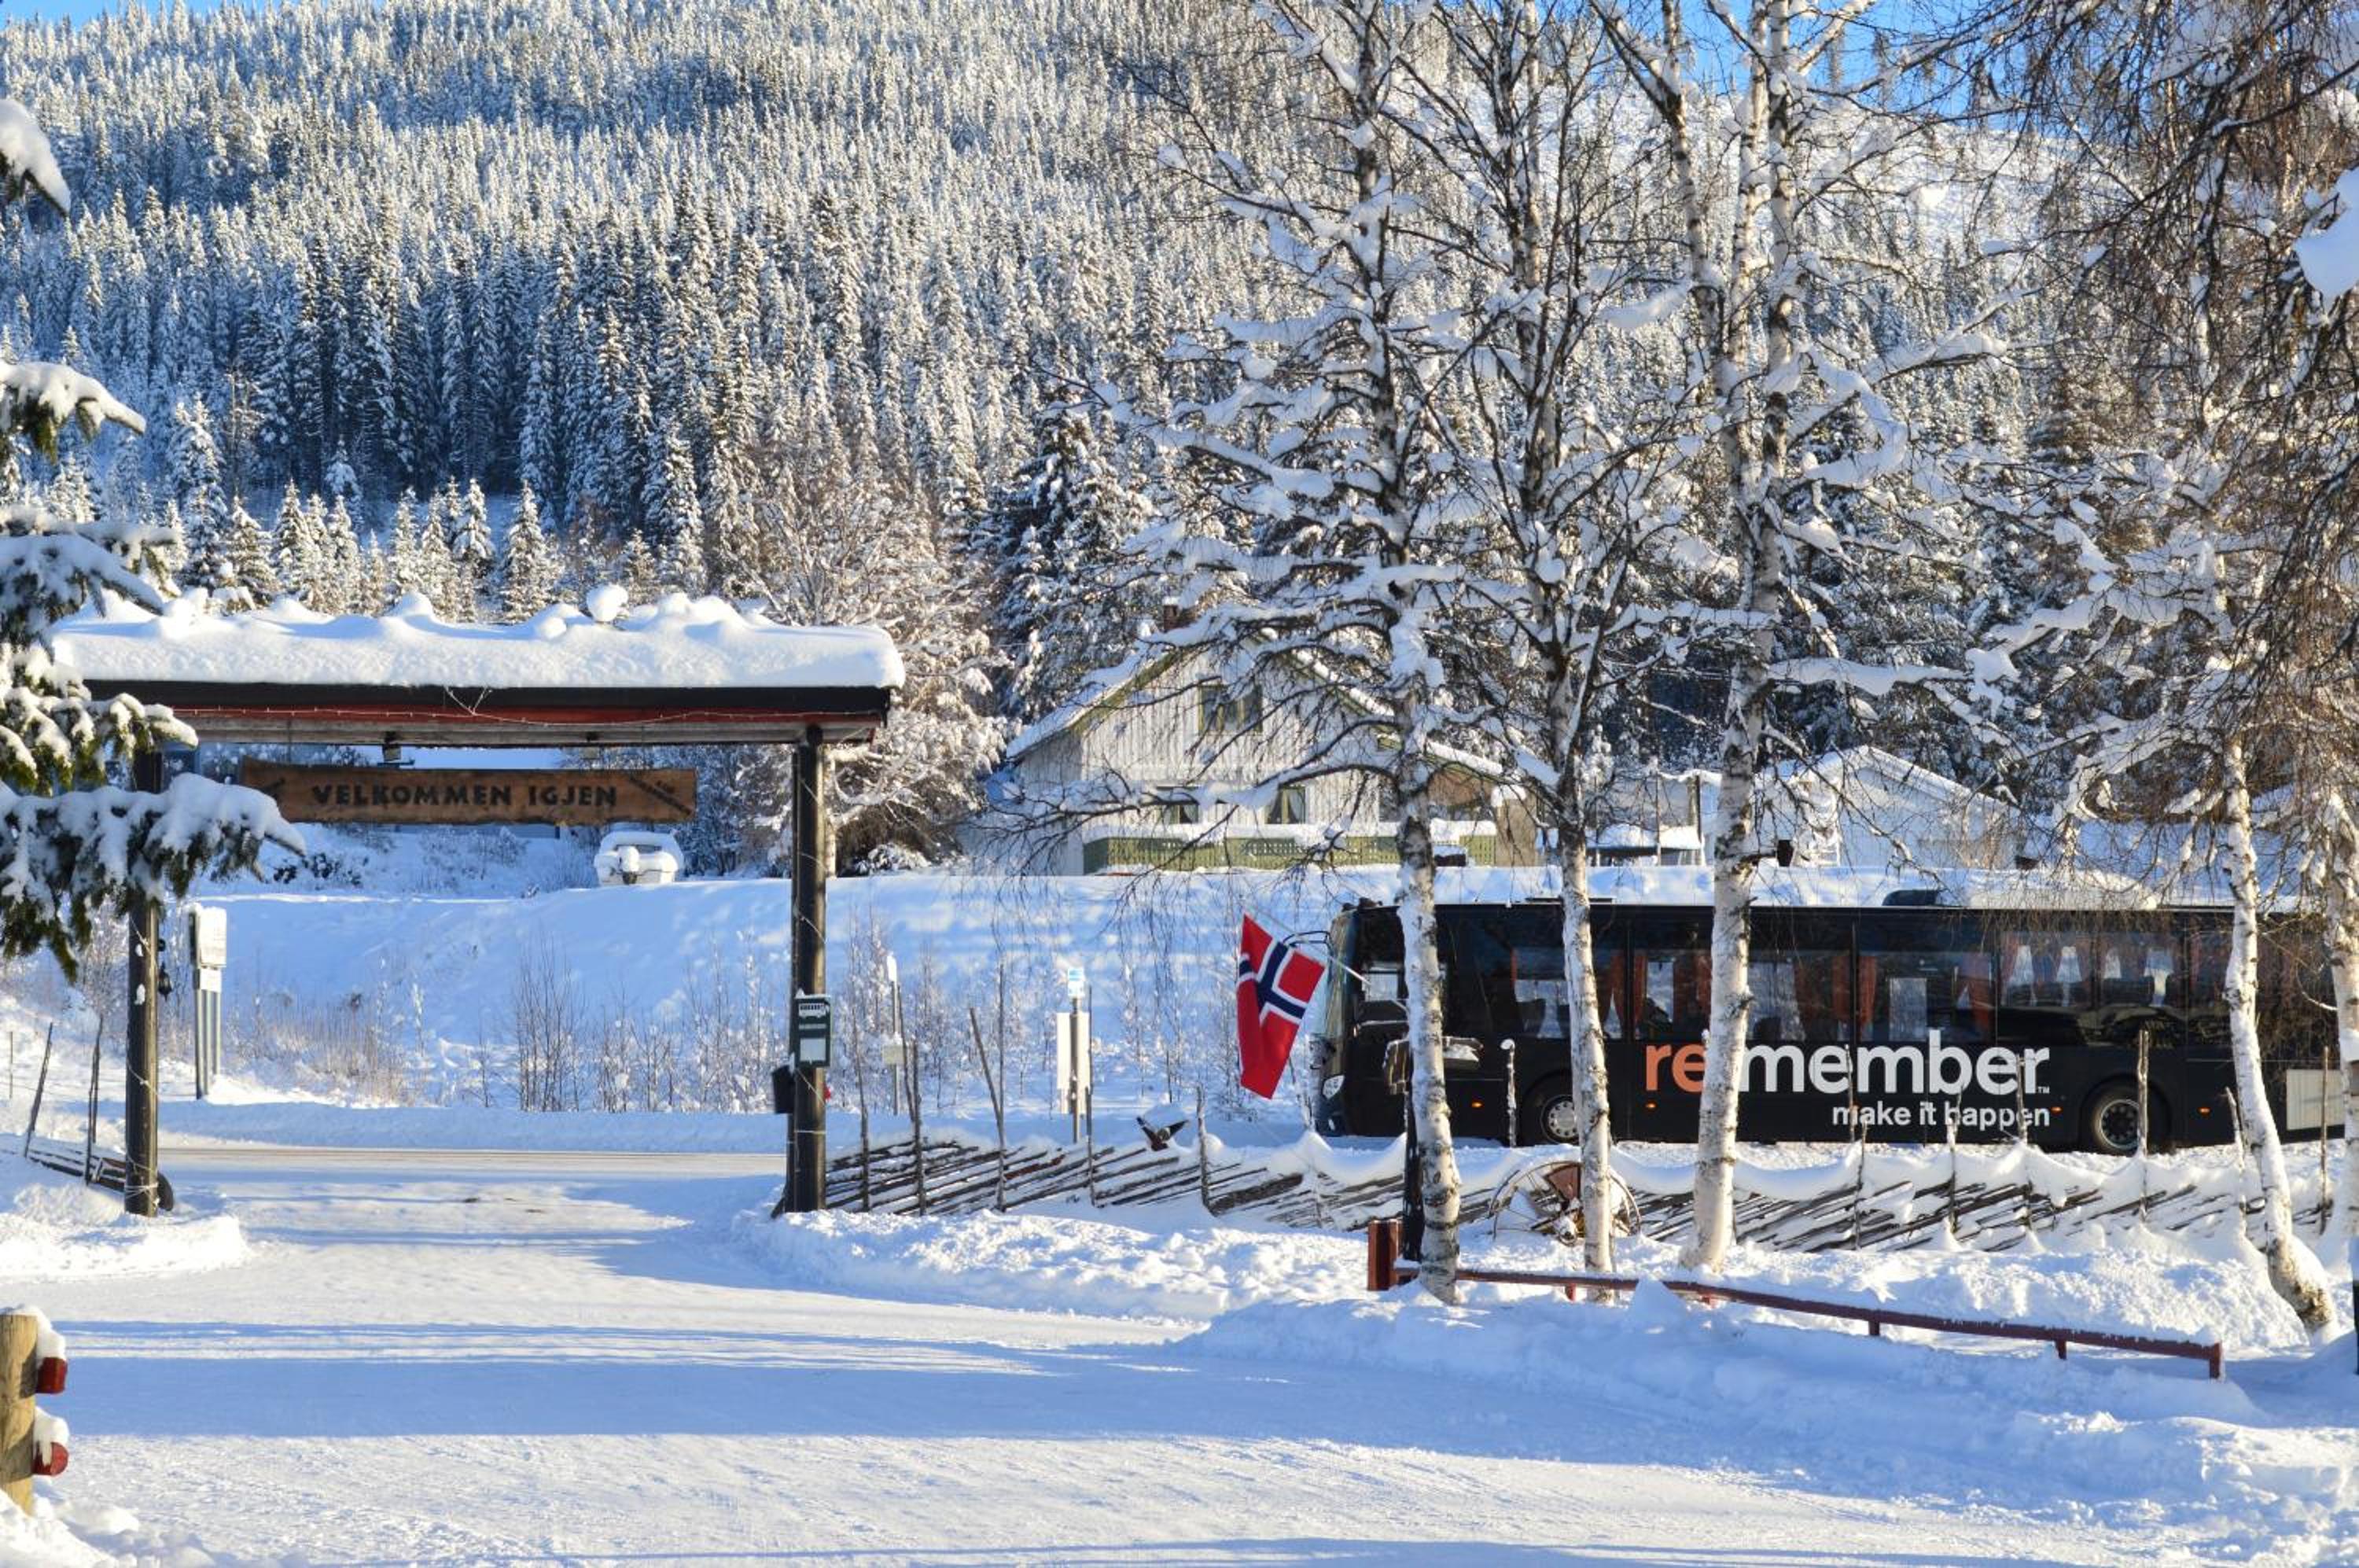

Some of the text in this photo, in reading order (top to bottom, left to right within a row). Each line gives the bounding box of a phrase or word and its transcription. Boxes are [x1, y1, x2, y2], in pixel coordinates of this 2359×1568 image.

[311, 785, 616, 807] VELKOMMEN IGJEN
[1832, 1100, 2050, 1131] make it happen
